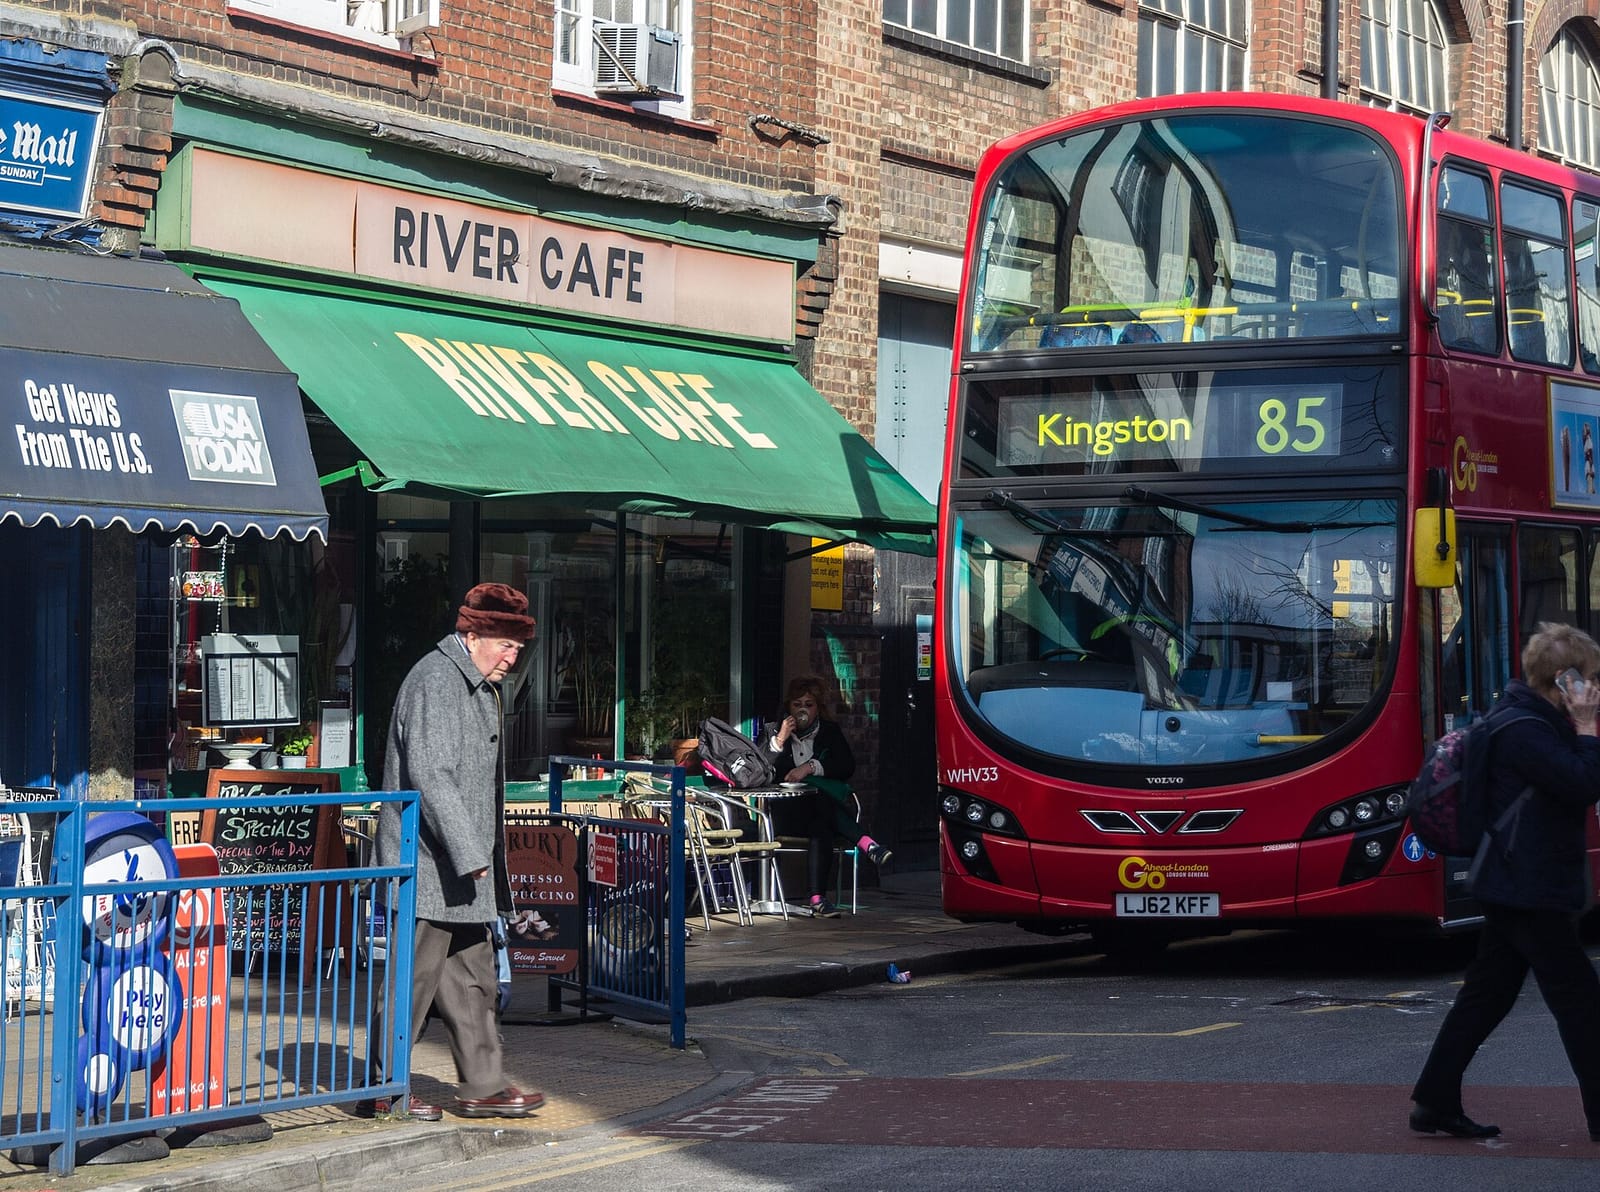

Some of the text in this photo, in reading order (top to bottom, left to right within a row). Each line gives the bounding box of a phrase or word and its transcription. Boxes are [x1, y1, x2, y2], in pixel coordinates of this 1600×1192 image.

[12, 120, 78, 167] Mail
[0, 165, 39, 180] SUNDAY
[393, 206, 644, 304] RIVER CAFE
[394, 331, 778, 449] RIVER CAFE
[24, 379, 121, 429] Get News
[204, 402, 258, 441] USA
[1038, 413, 1191, 456] Kingston
[1256, 397, 1327, 454] 85
[15, 424, 153, 475] From The U.S.
[184, 436, 264, 475] TODAY
[1454, 435, 1477, 492] Go
[947, 766, 998, 783] WHV33
[215, 845, 252, 858] SPECIAL
[288, 841, 313, 857] DAY
[228, 861, 252, 875] DAY
[511, 874, 563, 884] PRESSO
[1118, 856, 1166, 889] Go
[1143, 863, 1209, 871] Ahead-London
[511, 890, 575, 900] PUCCINO
[1124, 896, 1211, 914] LJ62 KFF
[513, 951, 566, 963] Being Served
[126, 989, 163, 1011] Play
[121, 1010, 163, 1029] here
